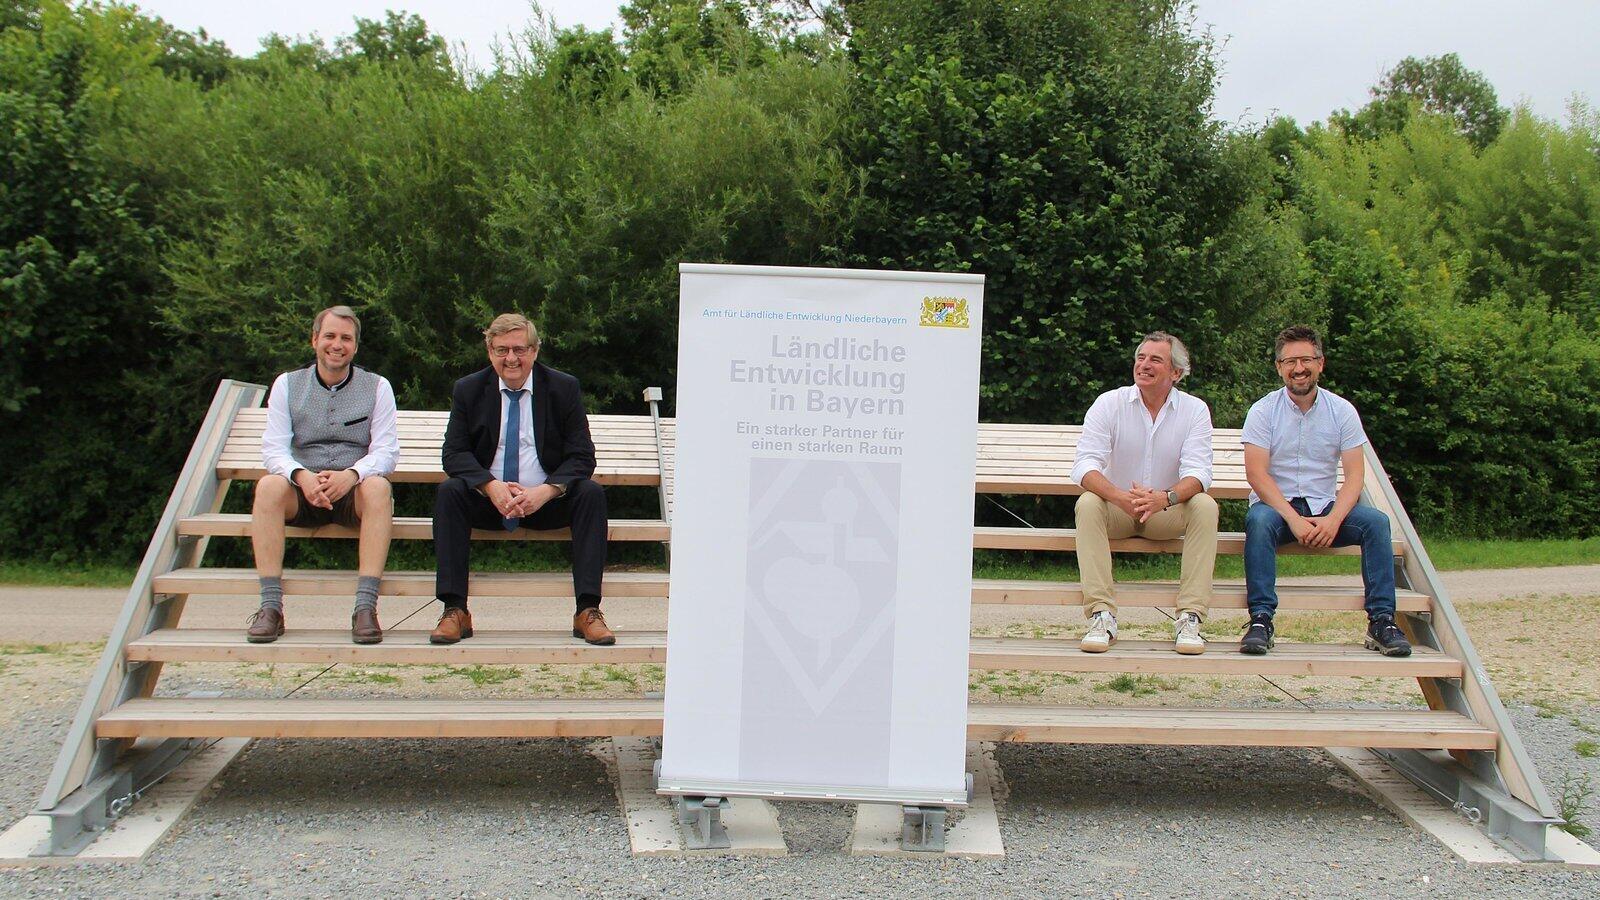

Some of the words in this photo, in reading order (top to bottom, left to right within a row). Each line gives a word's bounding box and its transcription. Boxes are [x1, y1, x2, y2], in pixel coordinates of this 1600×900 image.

[703, 309, 722, 318] Amt
[724, 309, 738, 318] für
[787, 311, 842, 323] Entwicklung
[845, 314, 907, 325] Niederbayern
[772, 334, 906, 362] Ländliche
[730, 359, 906, 394] Entwicklung
[770, 388, 795, 411] in
[807, 389, 904, 419] Bayern
[736, 421, 759, 434] Ein
[765, 422, 816, 437] starker
[823, 425, 877, 439] Partner
[882, 427, 904, 440] für
[751, 438, 792, 451] einen
[798, 440, 853, 454] starken
[859, 442, 903, 455] Raum
